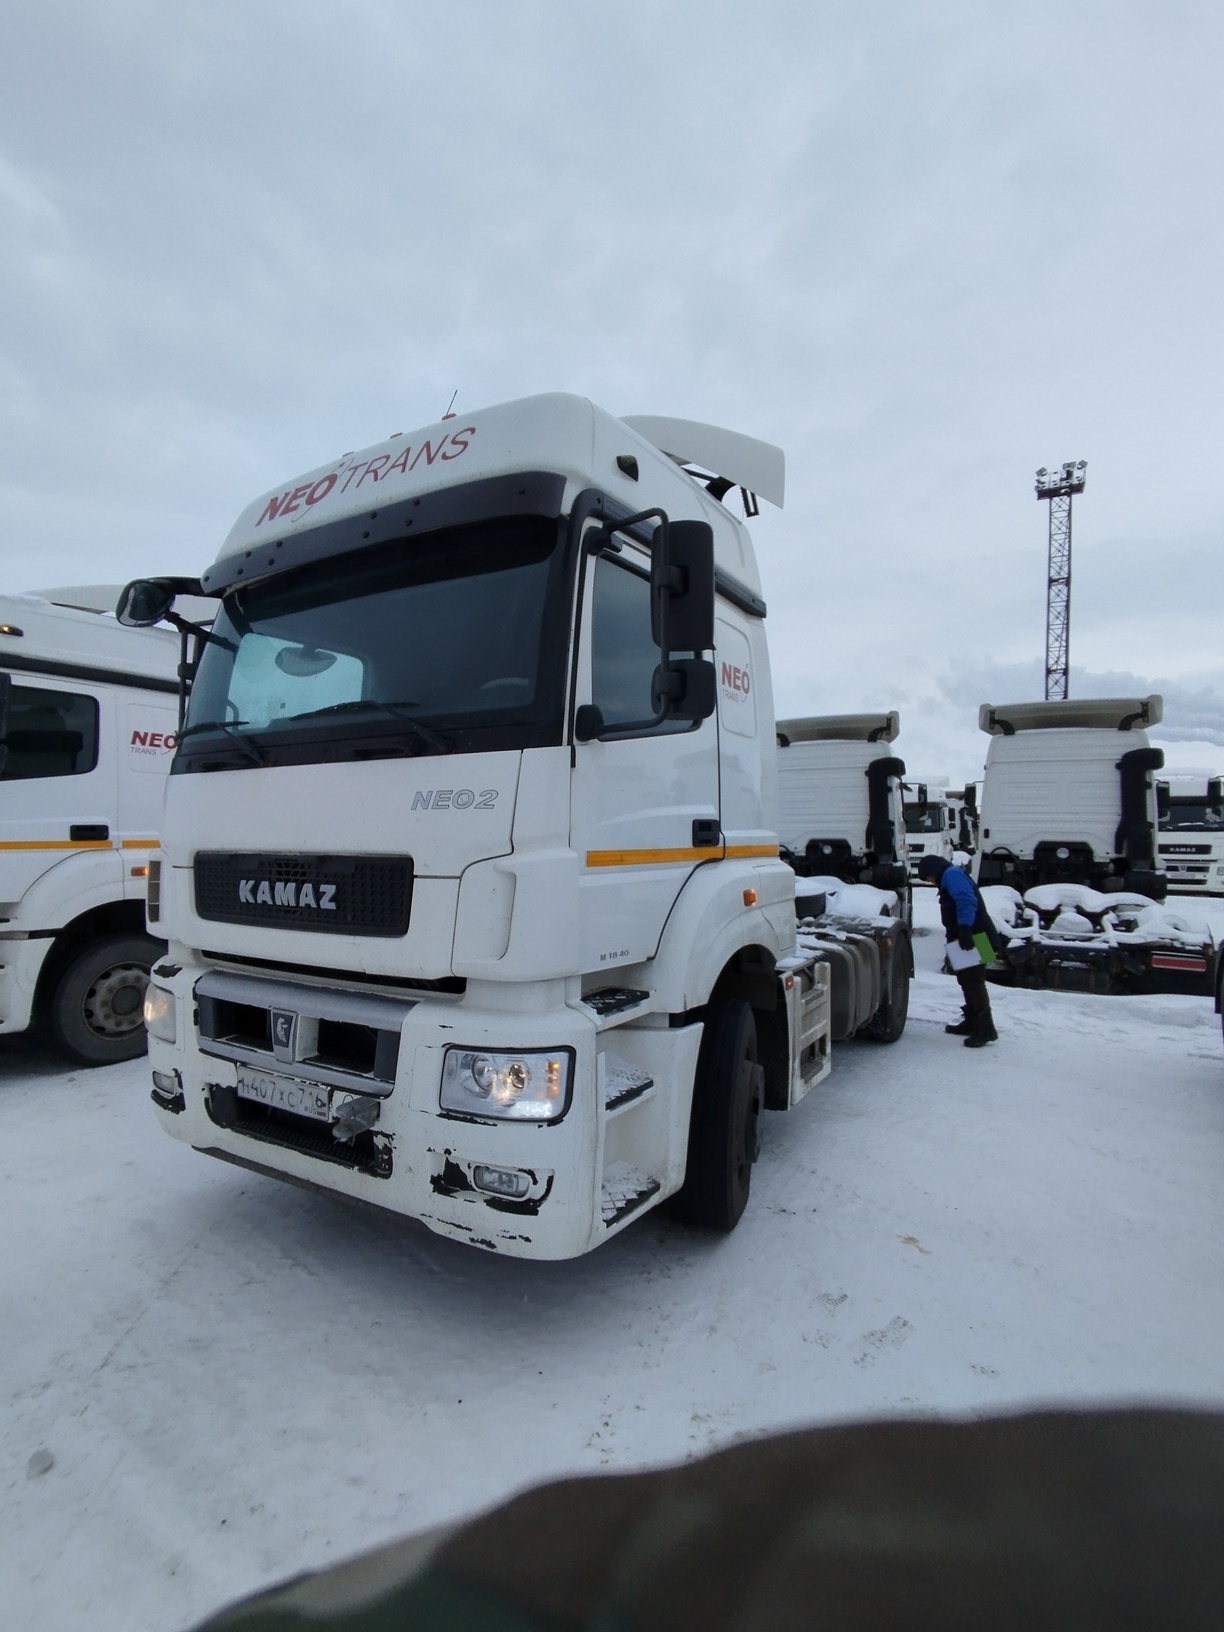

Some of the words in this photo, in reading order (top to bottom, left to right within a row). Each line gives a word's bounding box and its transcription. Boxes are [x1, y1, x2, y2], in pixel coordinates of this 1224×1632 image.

[722, 661, 750, 695] NEO
[131, 730, 178, 749] NEO
[130, 746, 157, 756] TRANS
[411, 789, 499, 810] NEO2
[239, 880, 336, 909] KAMAZ
